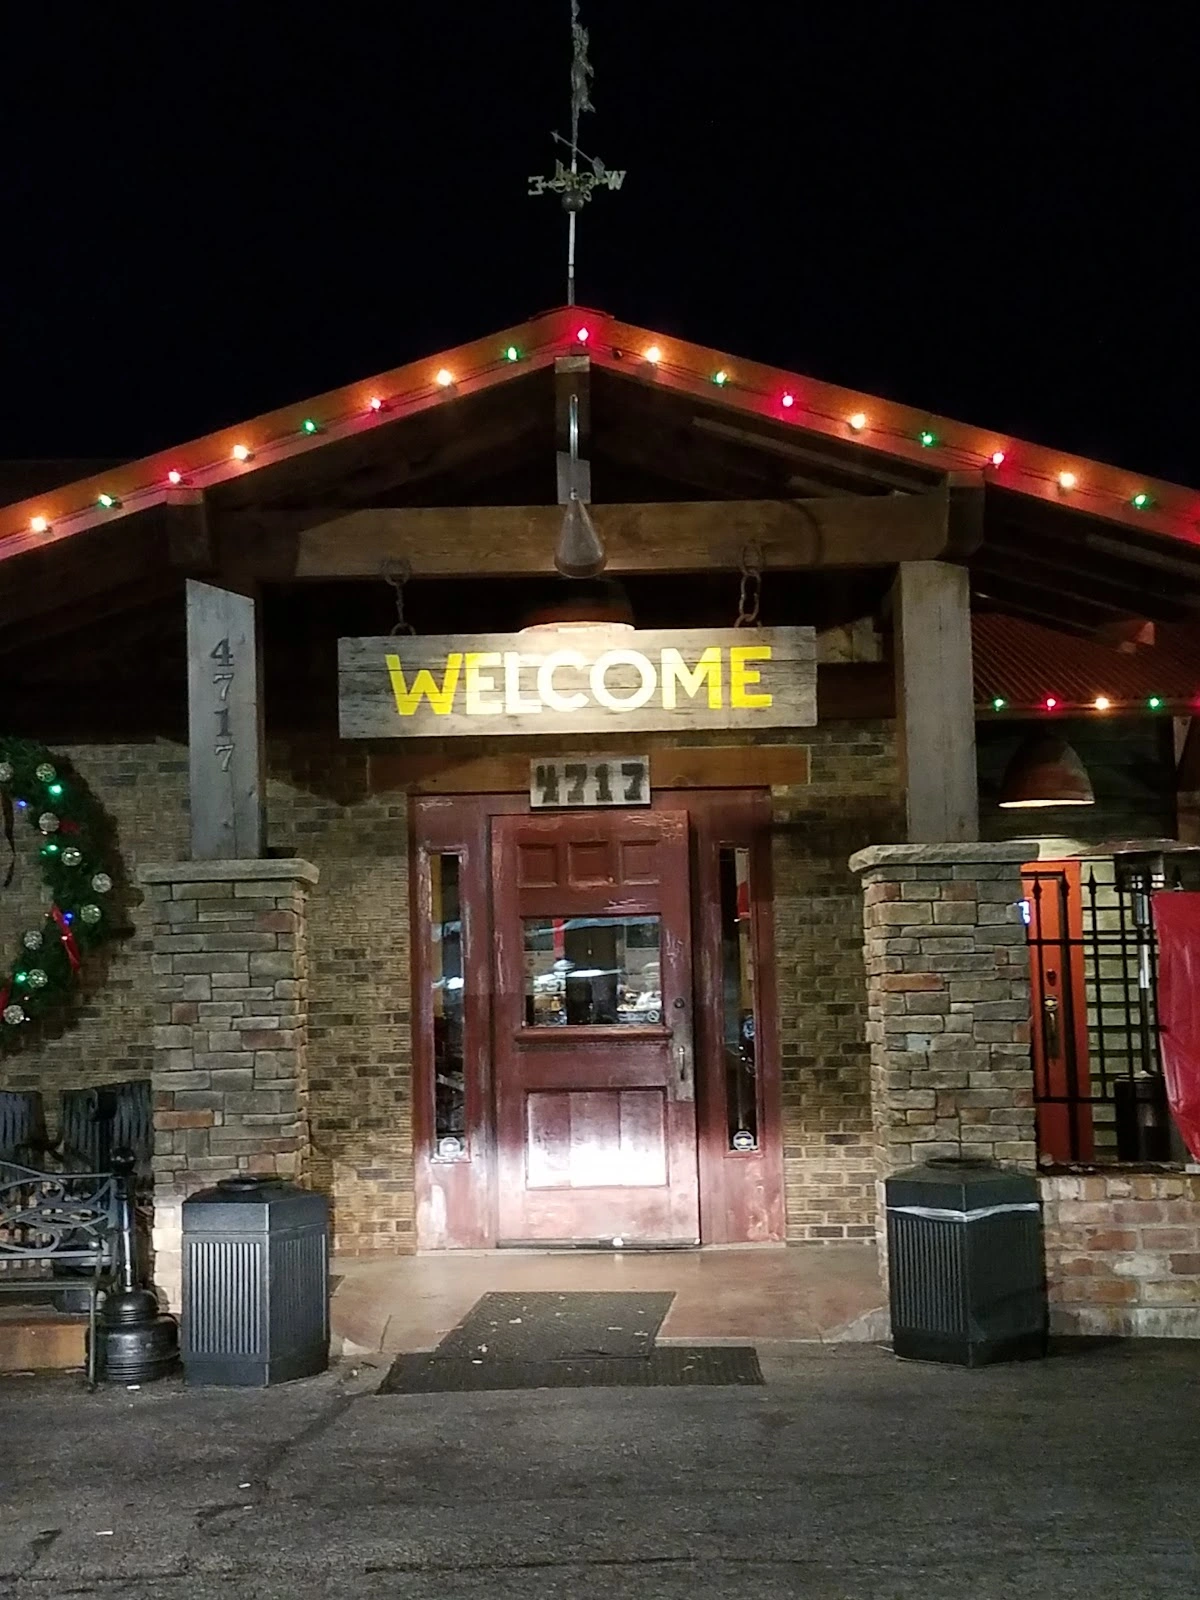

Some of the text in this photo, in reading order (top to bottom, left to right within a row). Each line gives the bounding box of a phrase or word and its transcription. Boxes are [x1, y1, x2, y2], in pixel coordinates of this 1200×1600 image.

[605, 170, 627, 190] W
[210, 636, 235, 773] 4717
[385, 645, 773, 716] WELCOME
[536, 762, 645, 803] 4717
